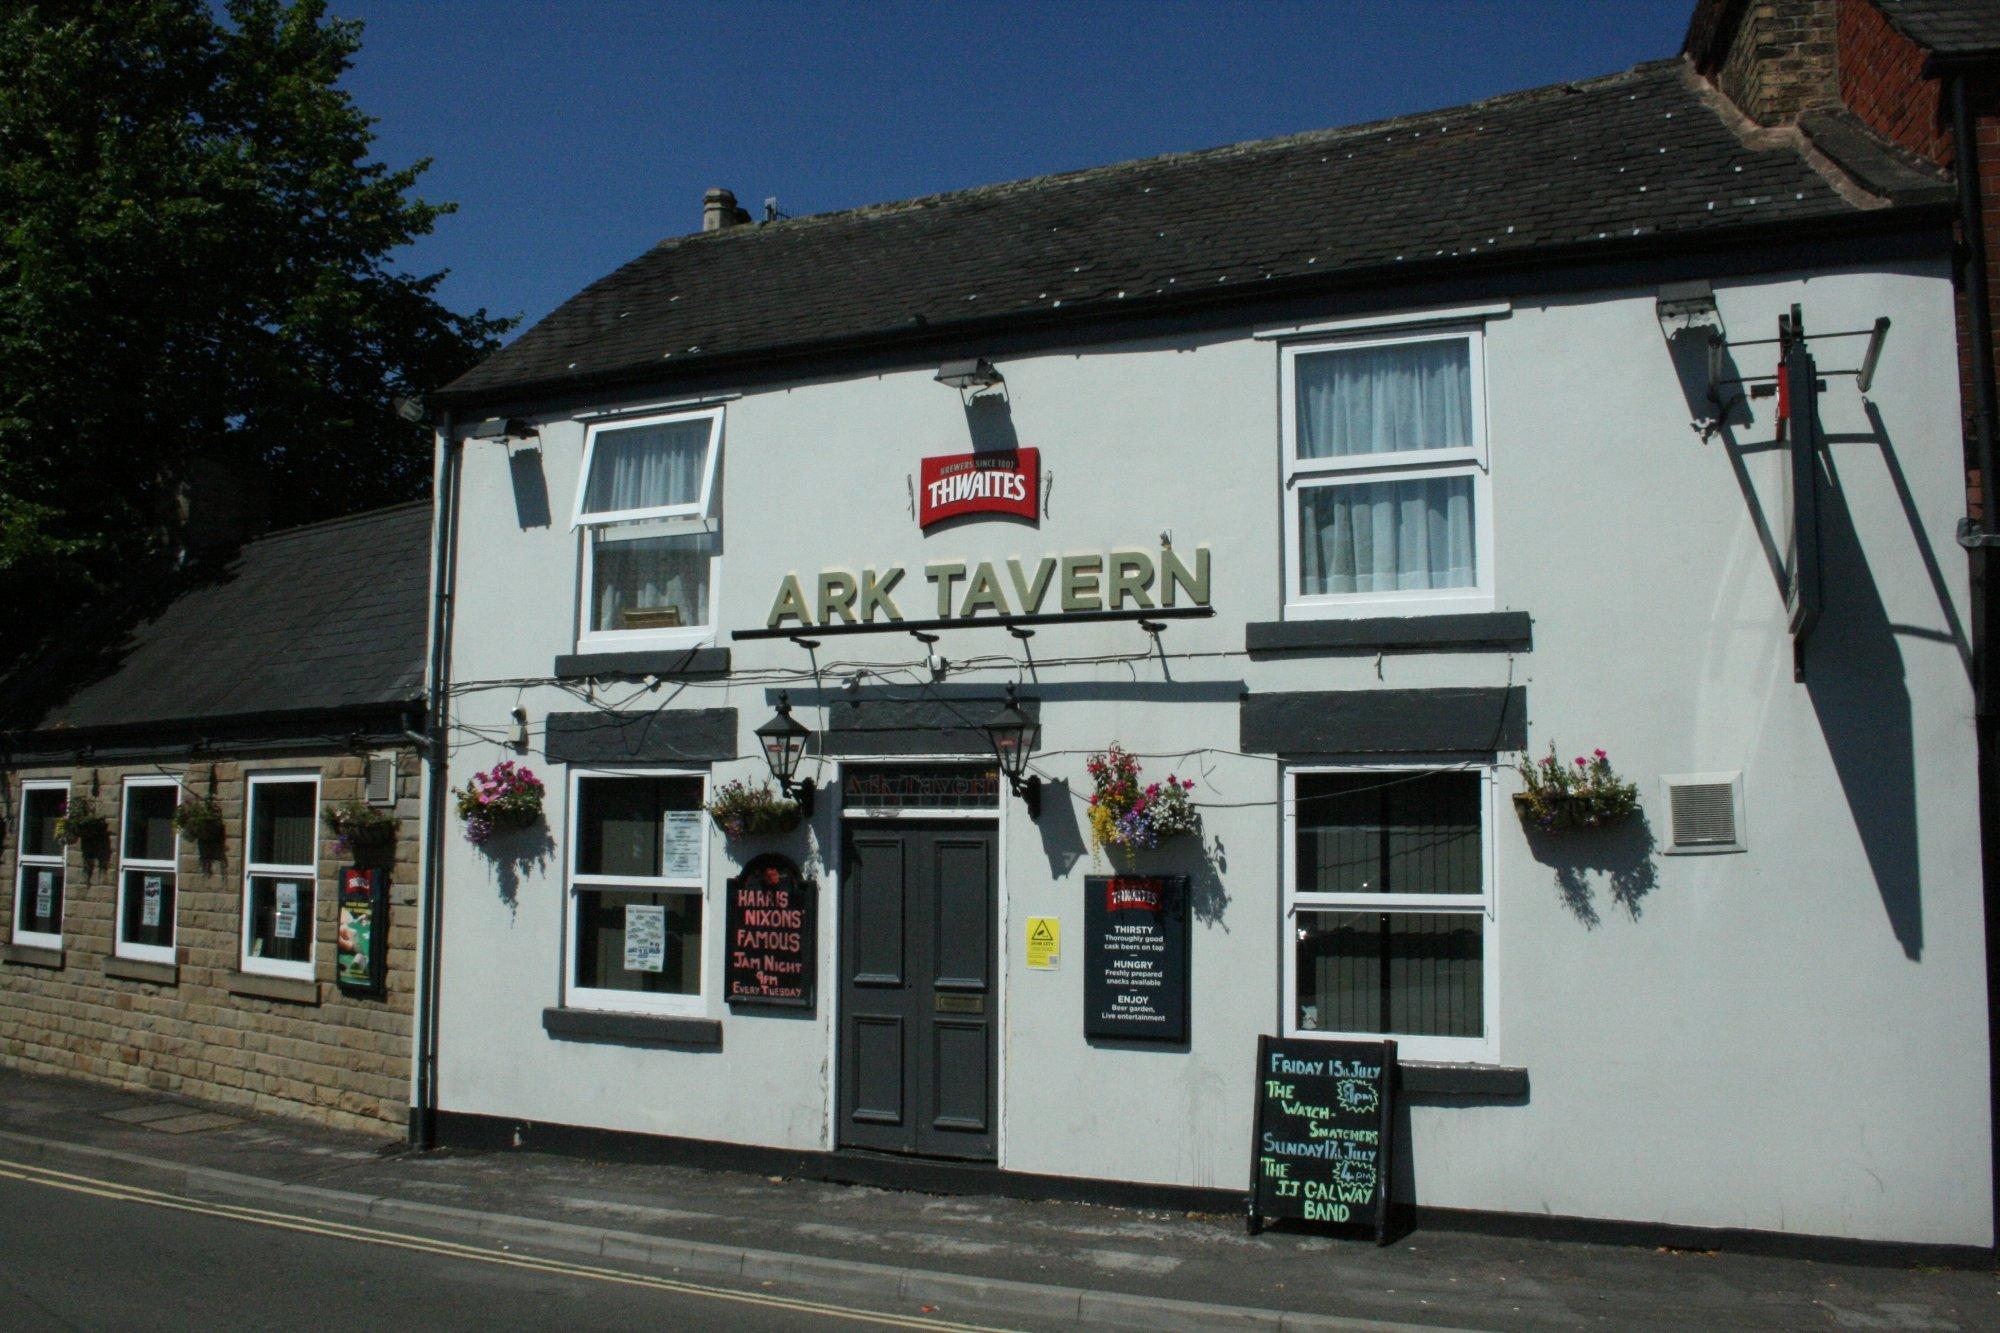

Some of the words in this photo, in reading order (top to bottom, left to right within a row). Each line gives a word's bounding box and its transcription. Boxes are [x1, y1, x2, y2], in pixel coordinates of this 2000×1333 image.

[976, 460, 995, 468] SINCE
[928, 471, 1026, 508] THWAITES
[766, 567, 905, 628] ARK
[925, 547, 1210, 617] TAVERN
[1112, 889, 1157, 905] THWAITES
[1105, 934, 1143, 943] Thoroughly
[1114, 925, 1154, 934] THIRSTY
[737, 930, 800, 952] FAMOUS
[1152, 944, 1163, 952] tap
[734, 952, 760, 969] JAM
[764, 955, 802, 973] NIGHT
[1114, 960, 1153, 969] HUNGRY
[1105, 970, 1129, 978] Freshly
[1131, 971, 1162, 979] prepared
[733, 981, 760, 995] EVERY
[761, 985, 801, 997] TUESDAY
[1118, 995, 1149, 1004] ENJOY
[1272, 1053, 1324, 1075] FRIDAY
[1350, 1061, 1381, 1078] JULY
[1265, 1081, 1295, 1099] THE
[1309, 1121, 1378, 1145] SNATCHERS
[1263, 1132, 1325, 1158] SUNDAY
[1343, 1142, 1377, 1161] JULY
[1261, 1157, 1290, 1178] THE
[1304, 1181, 1374, 1205] GALWAY
[1304, 1200, 1350, 1223] BAND
